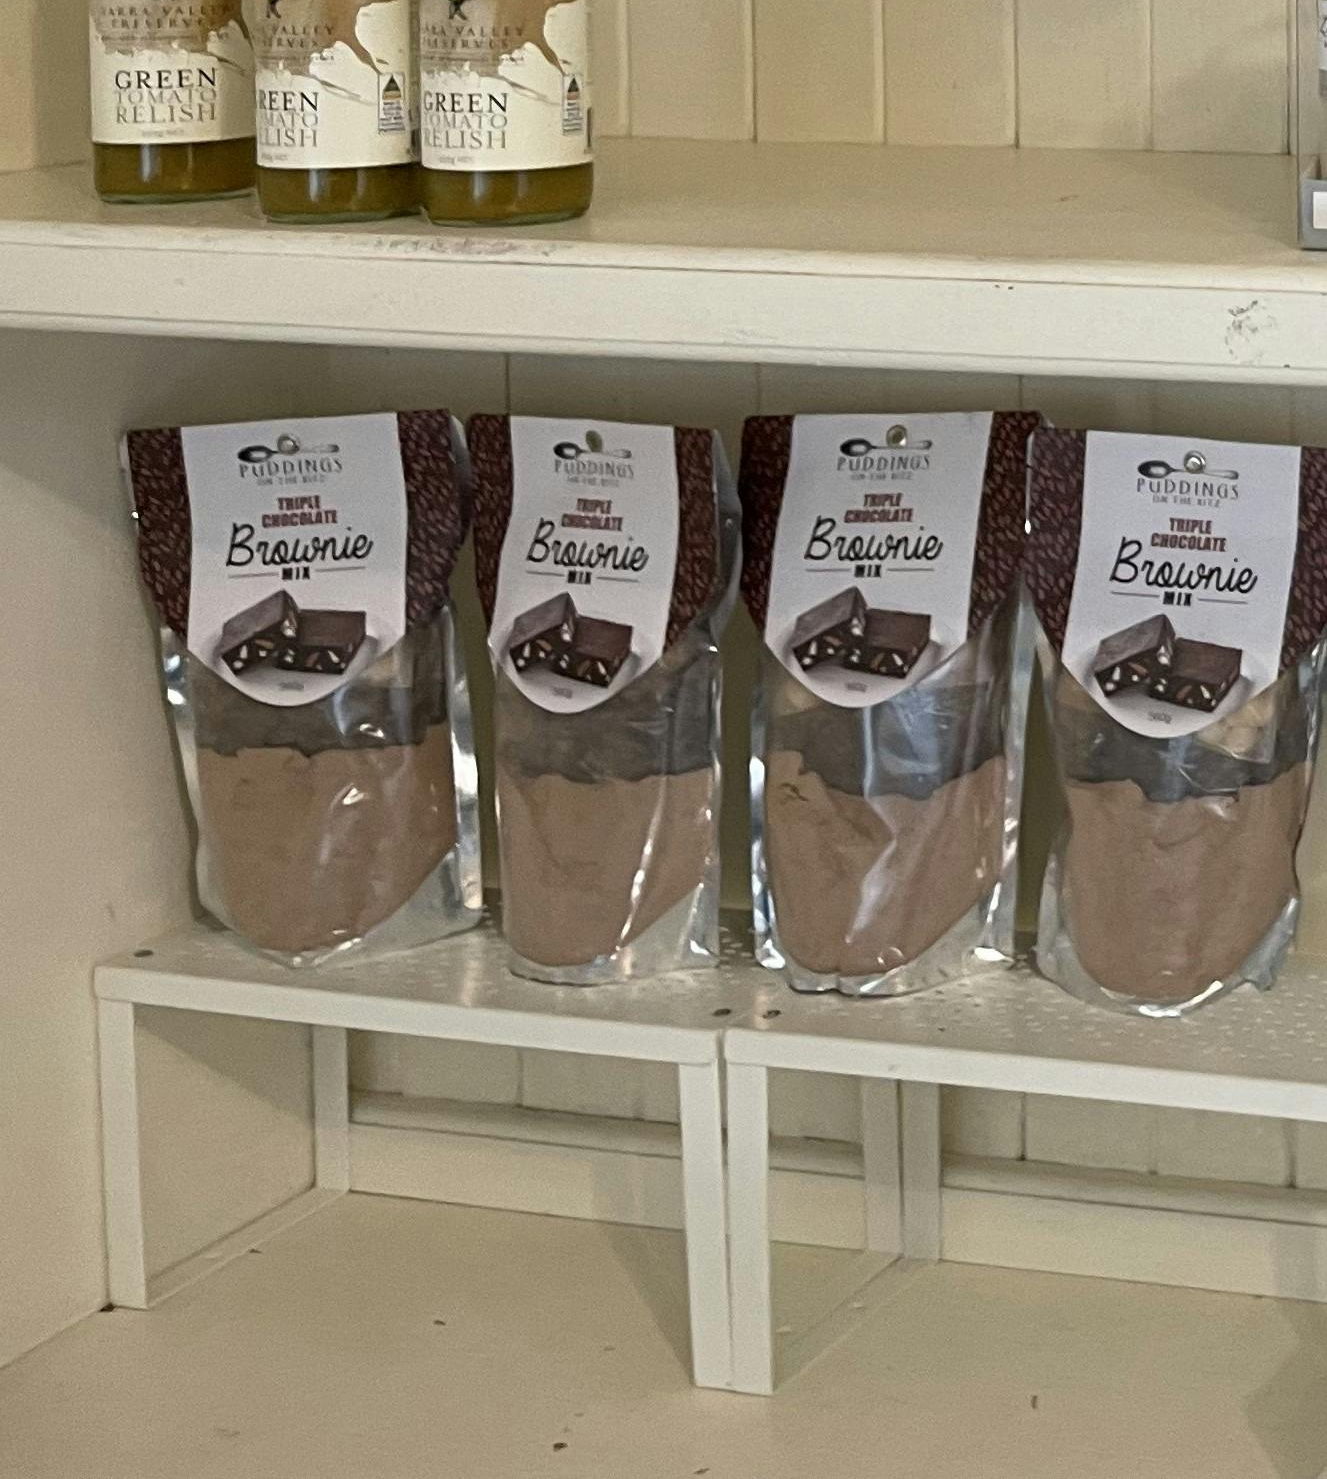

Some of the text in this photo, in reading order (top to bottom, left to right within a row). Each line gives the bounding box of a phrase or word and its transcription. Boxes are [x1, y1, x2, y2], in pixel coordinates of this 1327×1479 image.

[115, 67, 216, 90] GREEN
[423, 93, 508, 114] GREEN
[117, 103, 215, 124] RELISH
[423, 130, 506, 149] RELISH
[239, 457, 343, 478] PUDDINGS
[837, 455, 931, 472] PUDDINGS
[1137, 478, 1240, 499] PUDDINGS
[278, 495, 320, 510] TRIPLE
[863, 492, 903, 507] TRIPLE
[262, 510, 338, 528] CHOCOLATE
[844, 506, 914, 524] CHOCOLATE
[1170, 517, 1213, 534] TRIPLE
[225, 522, 374, 567] Brownie
[525, 520, 649, 573] Brownie
[803, 516, 943, 563] Brownie
[1151, 533, 1226, 552] CHOCOLATE
[282, 566, 310, 580] MIX
[855, 564, 882, 579] MIX
[1109, 539, 1258, 594] Brownie
[1163, 591, 1192, 606] MIX
